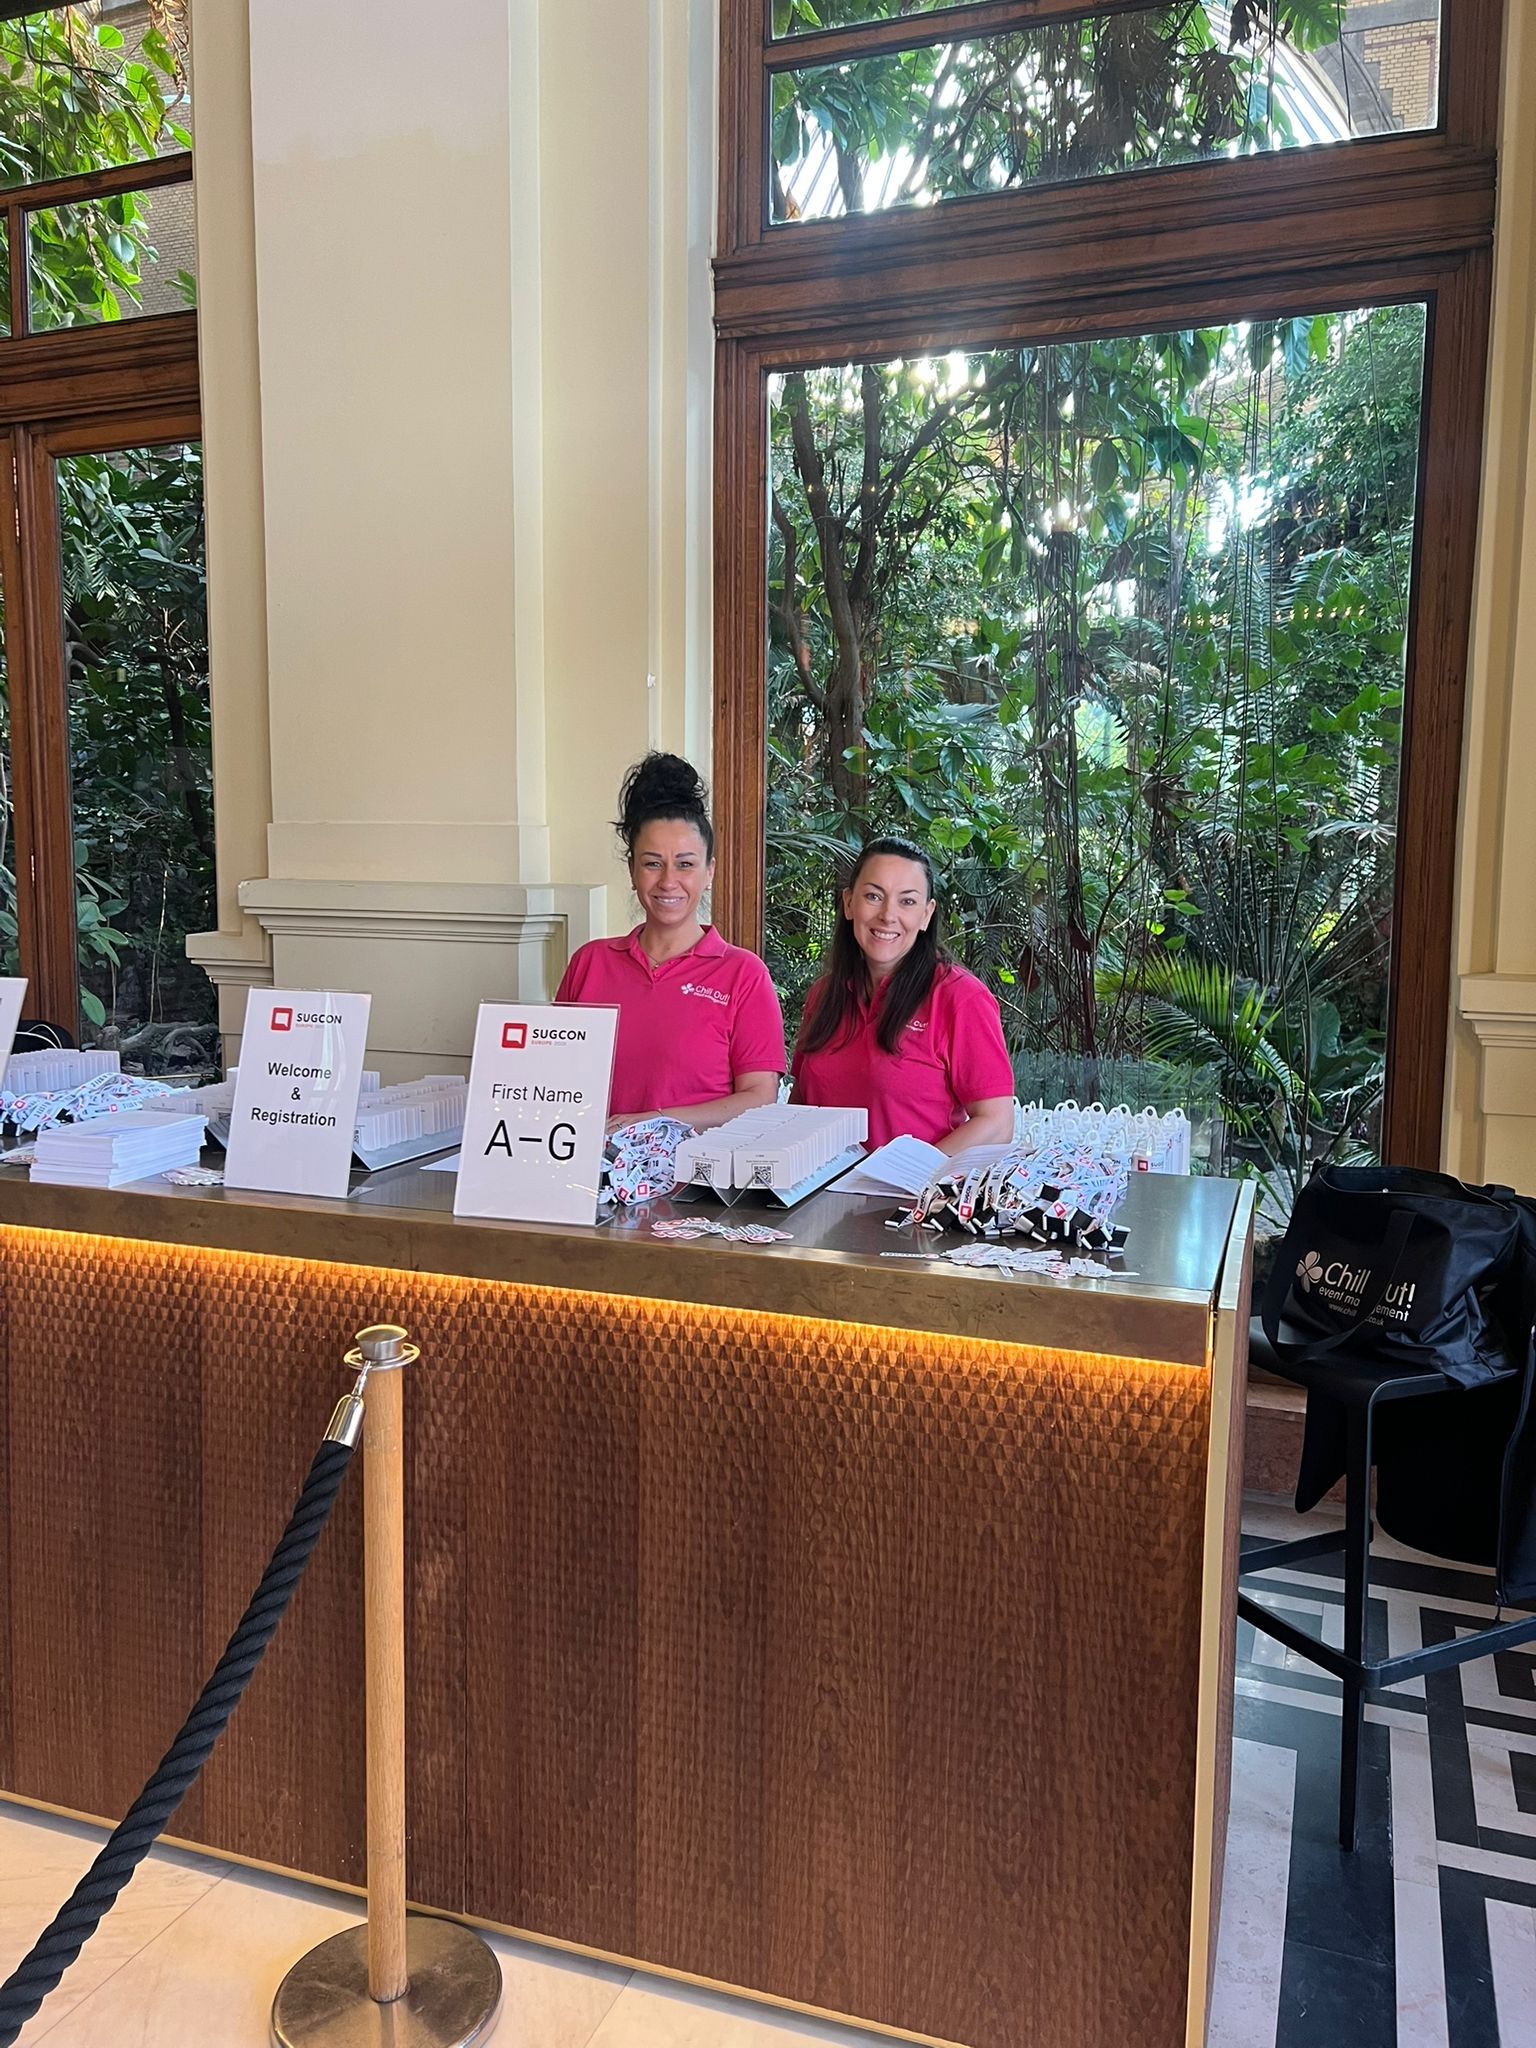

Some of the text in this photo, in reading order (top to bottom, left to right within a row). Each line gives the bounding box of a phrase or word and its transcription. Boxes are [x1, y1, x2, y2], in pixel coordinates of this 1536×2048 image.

[695, 985, 714, 996] Chill
[713, 990, 730, 1002] Out!
[296, 1012, 342, 1025] SUGCON
[532, 1028, 586, 1041] SUGCON
[268, 1062, 332, 1079] Welcome
[291, 1087, 301, 1100] &
[492, 1083, 583, 1103] First Name
[251, 1107, 336, 1127] Registration
[1324, 1262, 1416, 1309] Chill ut!
[1318, 1286, 1410, 1323] event maement
